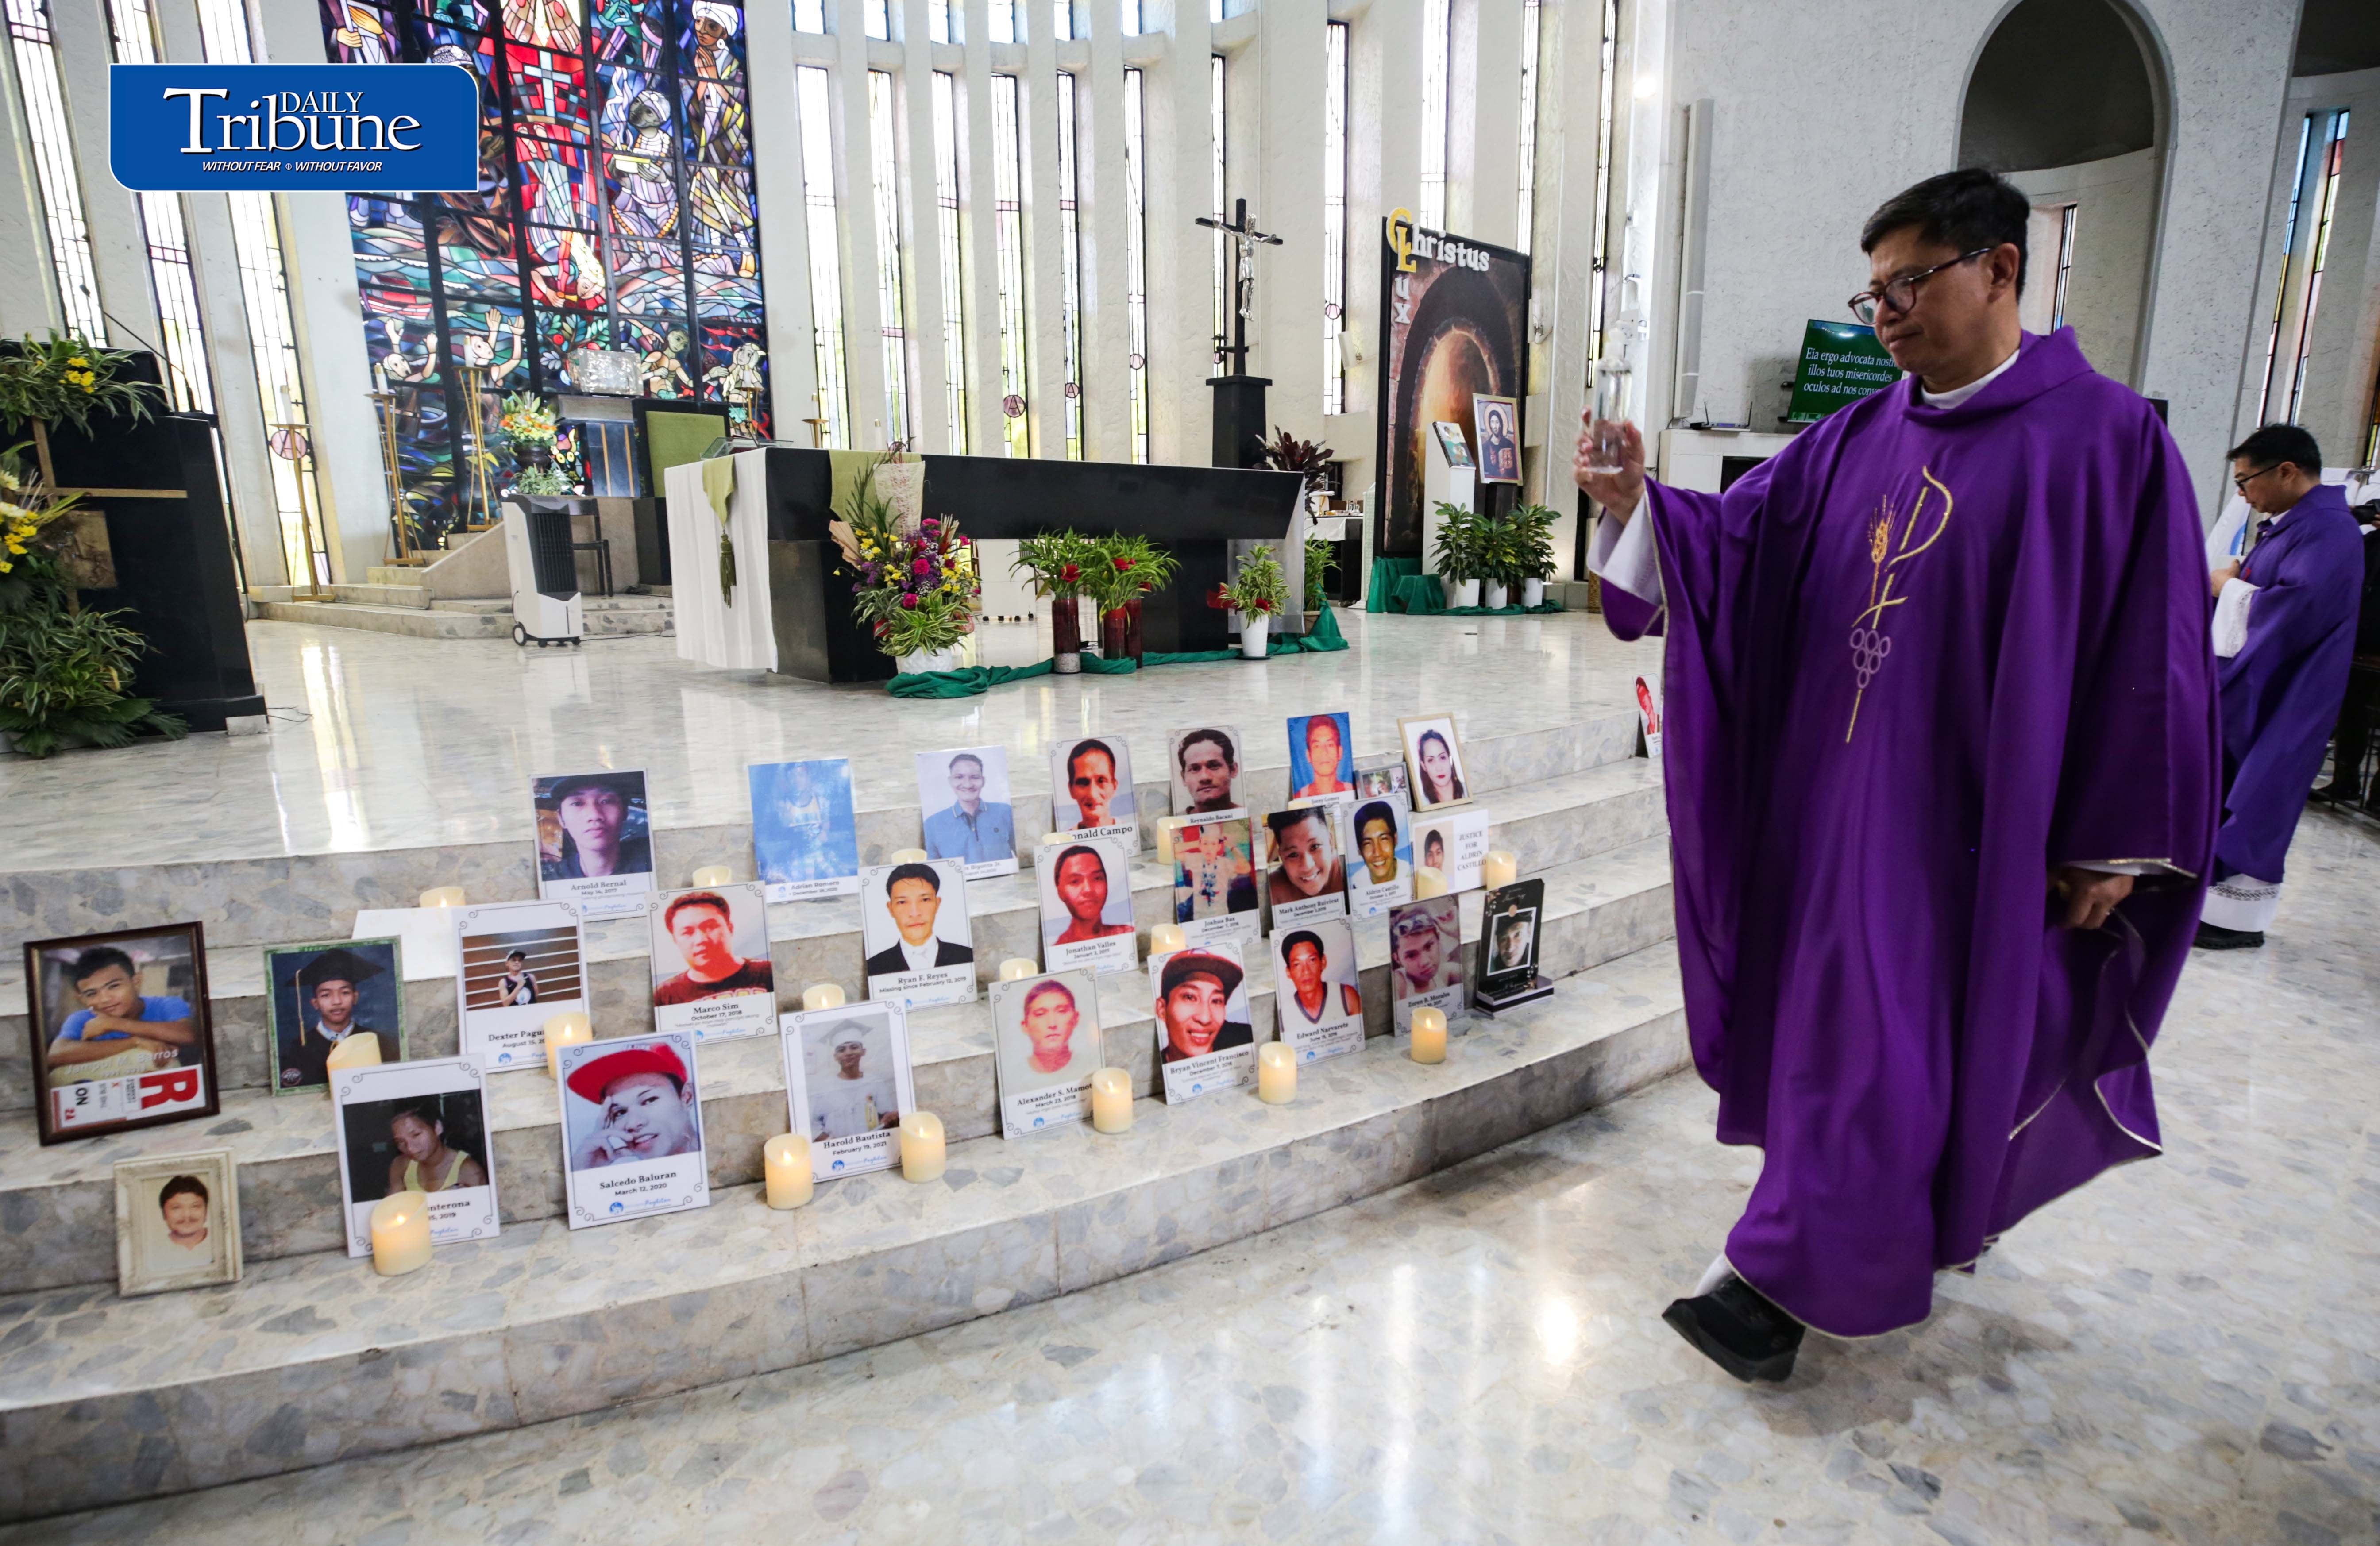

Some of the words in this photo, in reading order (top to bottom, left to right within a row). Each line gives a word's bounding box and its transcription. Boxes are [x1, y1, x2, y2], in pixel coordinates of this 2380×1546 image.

[1386, 207, 1490, 272] Christus
[1805, 347, 1818, 360] Eia
[1821, 352, 1839, 365] ergo
[1840, 351, 1875, 365] advocata
[1876, 357, 1898, 367] nostr
[1808, 364, 1826, 377] illos
[1827, 367, 1844, 378] tuos
[1845, 368, 1893, 382] misericordes
[1804, 381, 1830, 393] oculos
[1831, 382, 1843, 393] ad
[1843, 386, 1857, 395] nos
[1067, 829, 1098, 840] onald
[1100, 826, 1133, 836] Campo
[1459, 830, 1482, 840] JUSTICE
[1461, 850, 1484, 860] ALDRIN
[1457, 859, 1486, 871] CASTILLO
[601, 879, 627, 888] Bernal
[1066, 944, 1096, 956] Jonathan
[898, 976, 917, 986] Ryan
[927, 972, 948, 981] Reyes
[919, 979, 945, 988] February
[694, 1006, 720, 1014] Marco
[722, 1002, 739, 1011] Sim
[488, 1033, 518, 1041] Dexter
[520, 1029, 544, 1038] Pagu
[1297, 1029, 1319, 1040] Edward
[1170, 1064, 1190, 1075] Bryan
[1192, 1058, 1217, 1068] Vincent
[1218, 1051, 1249, 1062] Francisco
[1017, 1092, 1056, 1106] Alexander
[824, 1137, 853, 1149] Harold
[856, 1131, 891, 1143] Bautista
[833, 1146, 861, 1156] February
[599, 1177, 636, 1190] Salcedo
[639, 1171, 677, 1184] Baluran
[615, 1187, 637, 1196] March
[428, 1200, 471, 1212] nterona
